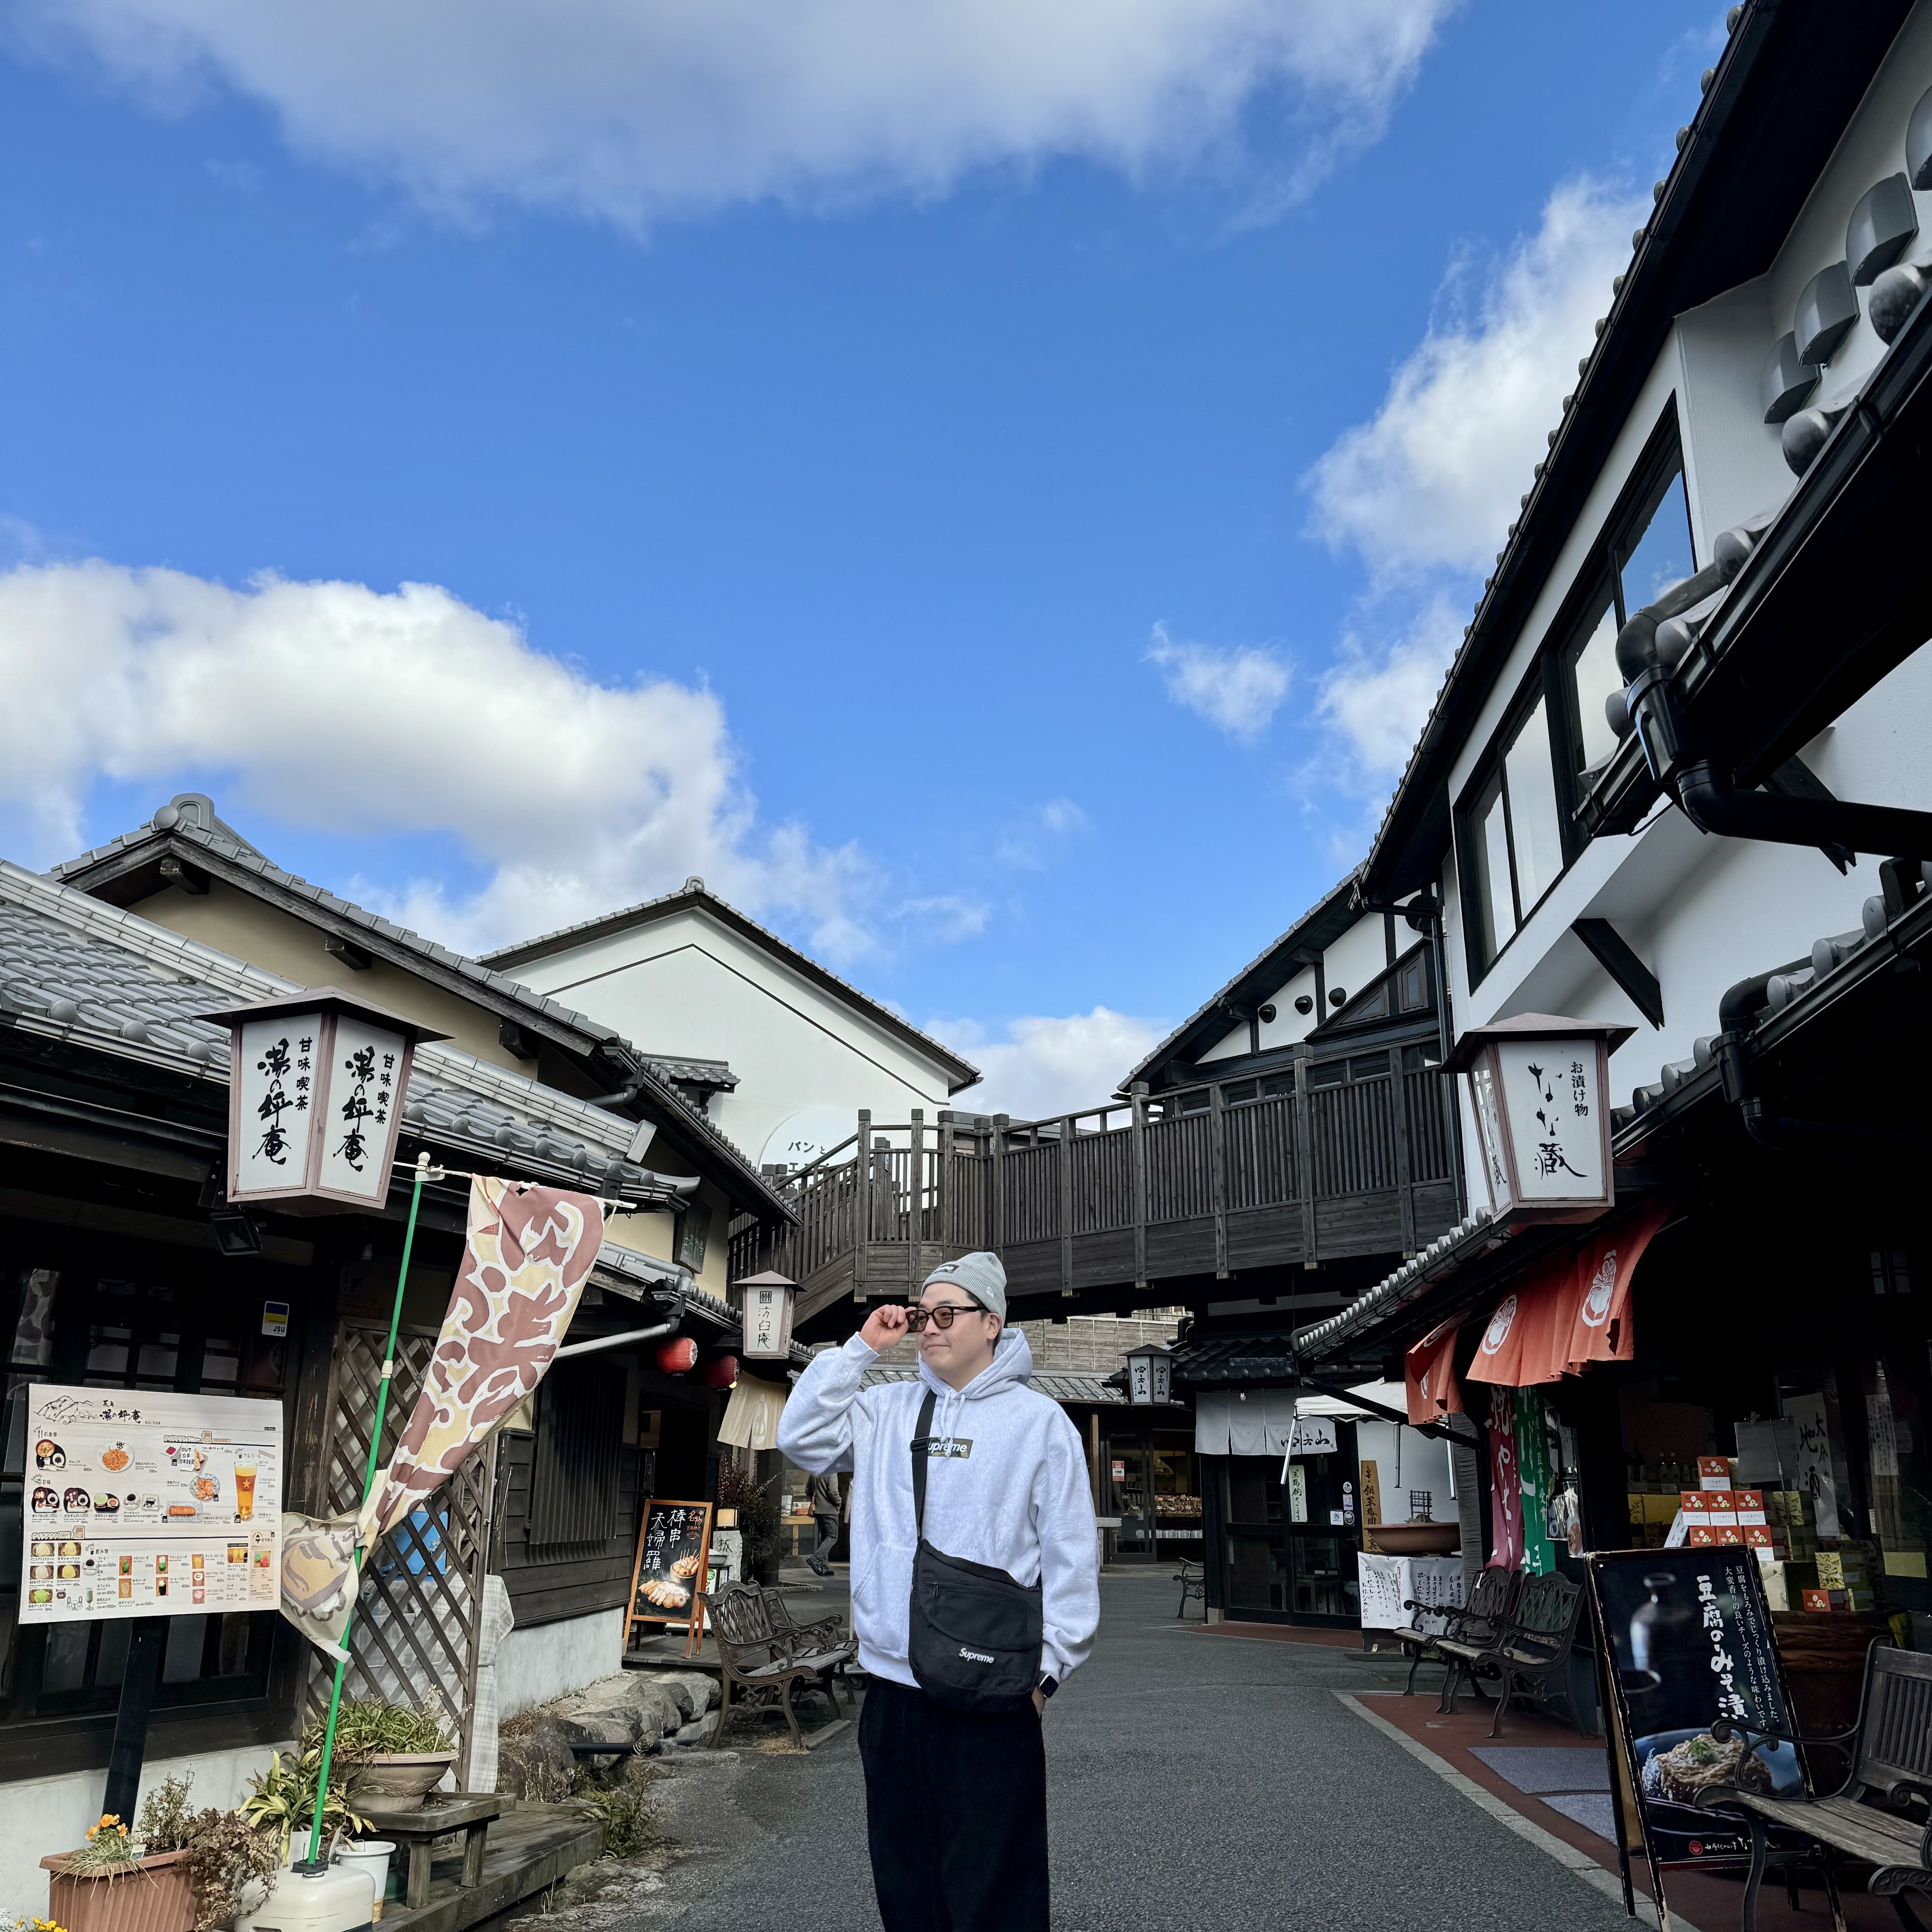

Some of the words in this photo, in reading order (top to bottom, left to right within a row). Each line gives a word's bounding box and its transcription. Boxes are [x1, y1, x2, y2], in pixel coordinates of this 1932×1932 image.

[252, 1038, 294, 1165] 湯の坪庵
[295, 1036, 313, 1111] 甘味喫茶
[333, 1046, 375, 1172] 湯の坪庵
[374, 1053, 396, 1125] 甘味喫茶
[1570, 1061, 1588, 1117] お漬け物
[643, 1512, 667, 1570] 天婦羅
[688, 1510, 703, 1526] 名物
[959, 1647, 994, 1664] Supreme
[1696, 1575, 1748, 1720] 豆腐のみそ漬
